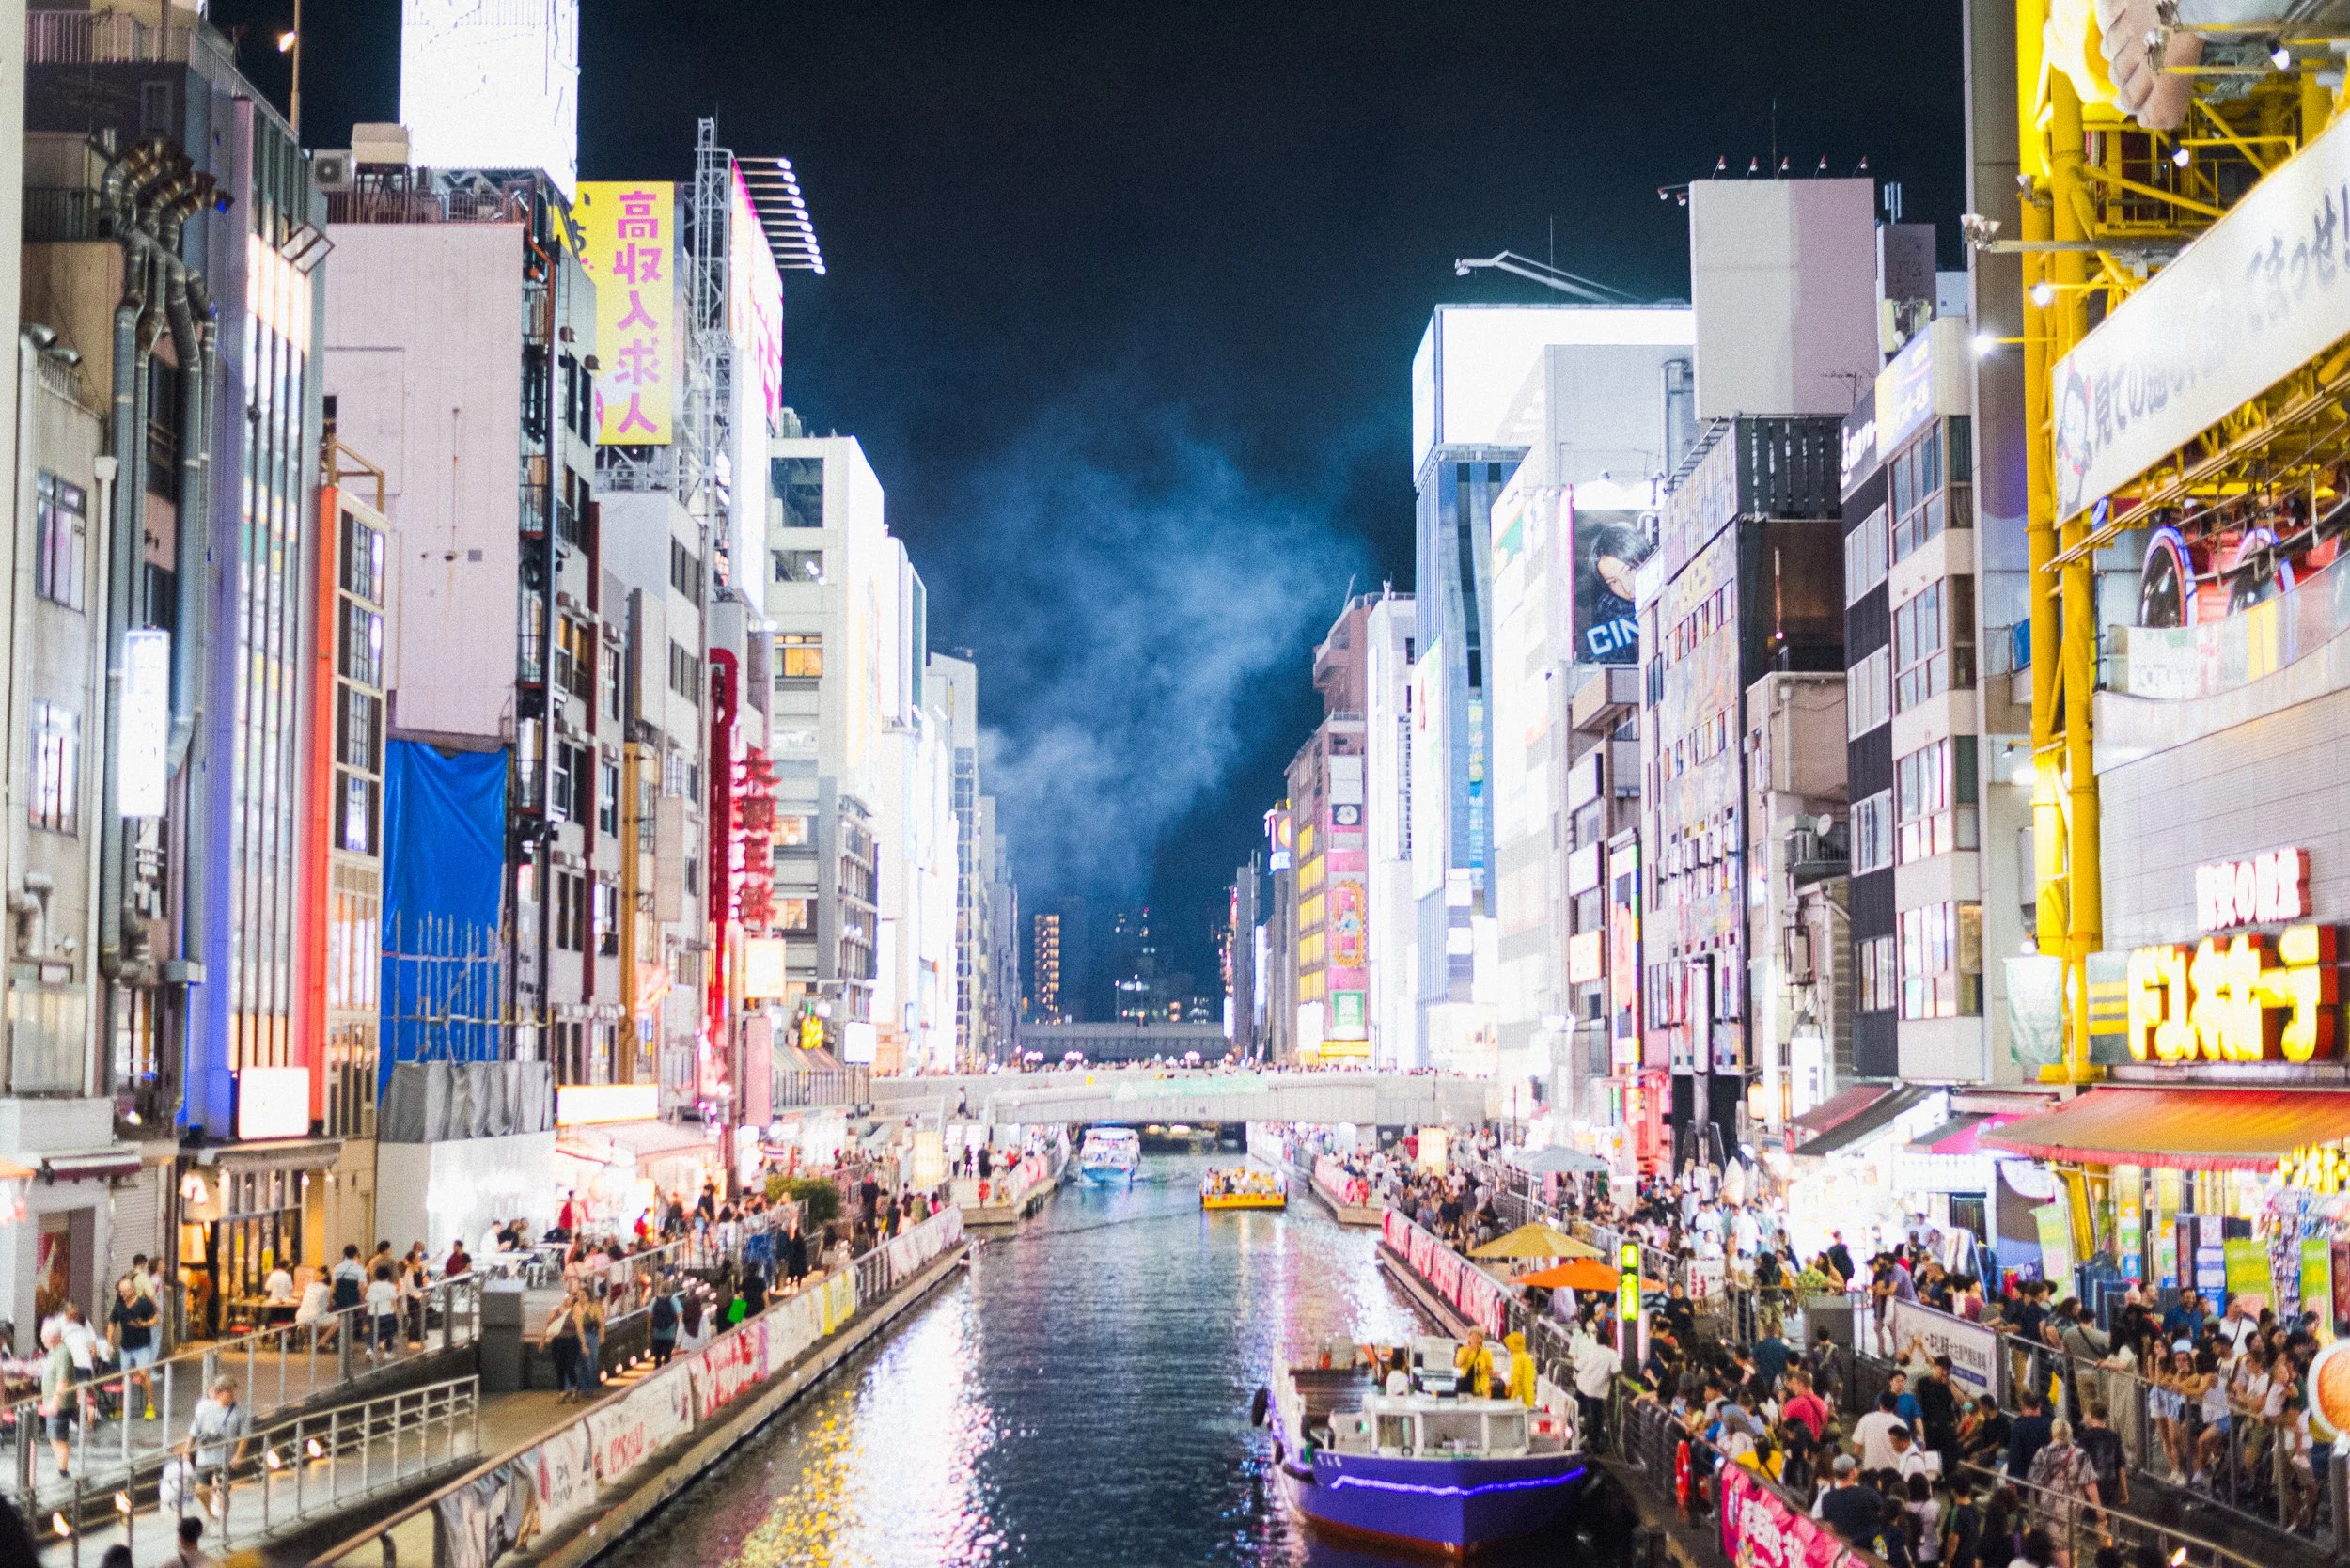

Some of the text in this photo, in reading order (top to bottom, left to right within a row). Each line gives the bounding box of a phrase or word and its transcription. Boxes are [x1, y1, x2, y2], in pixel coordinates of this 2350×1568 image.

[613, 190, 663, 435] 高収入求人
